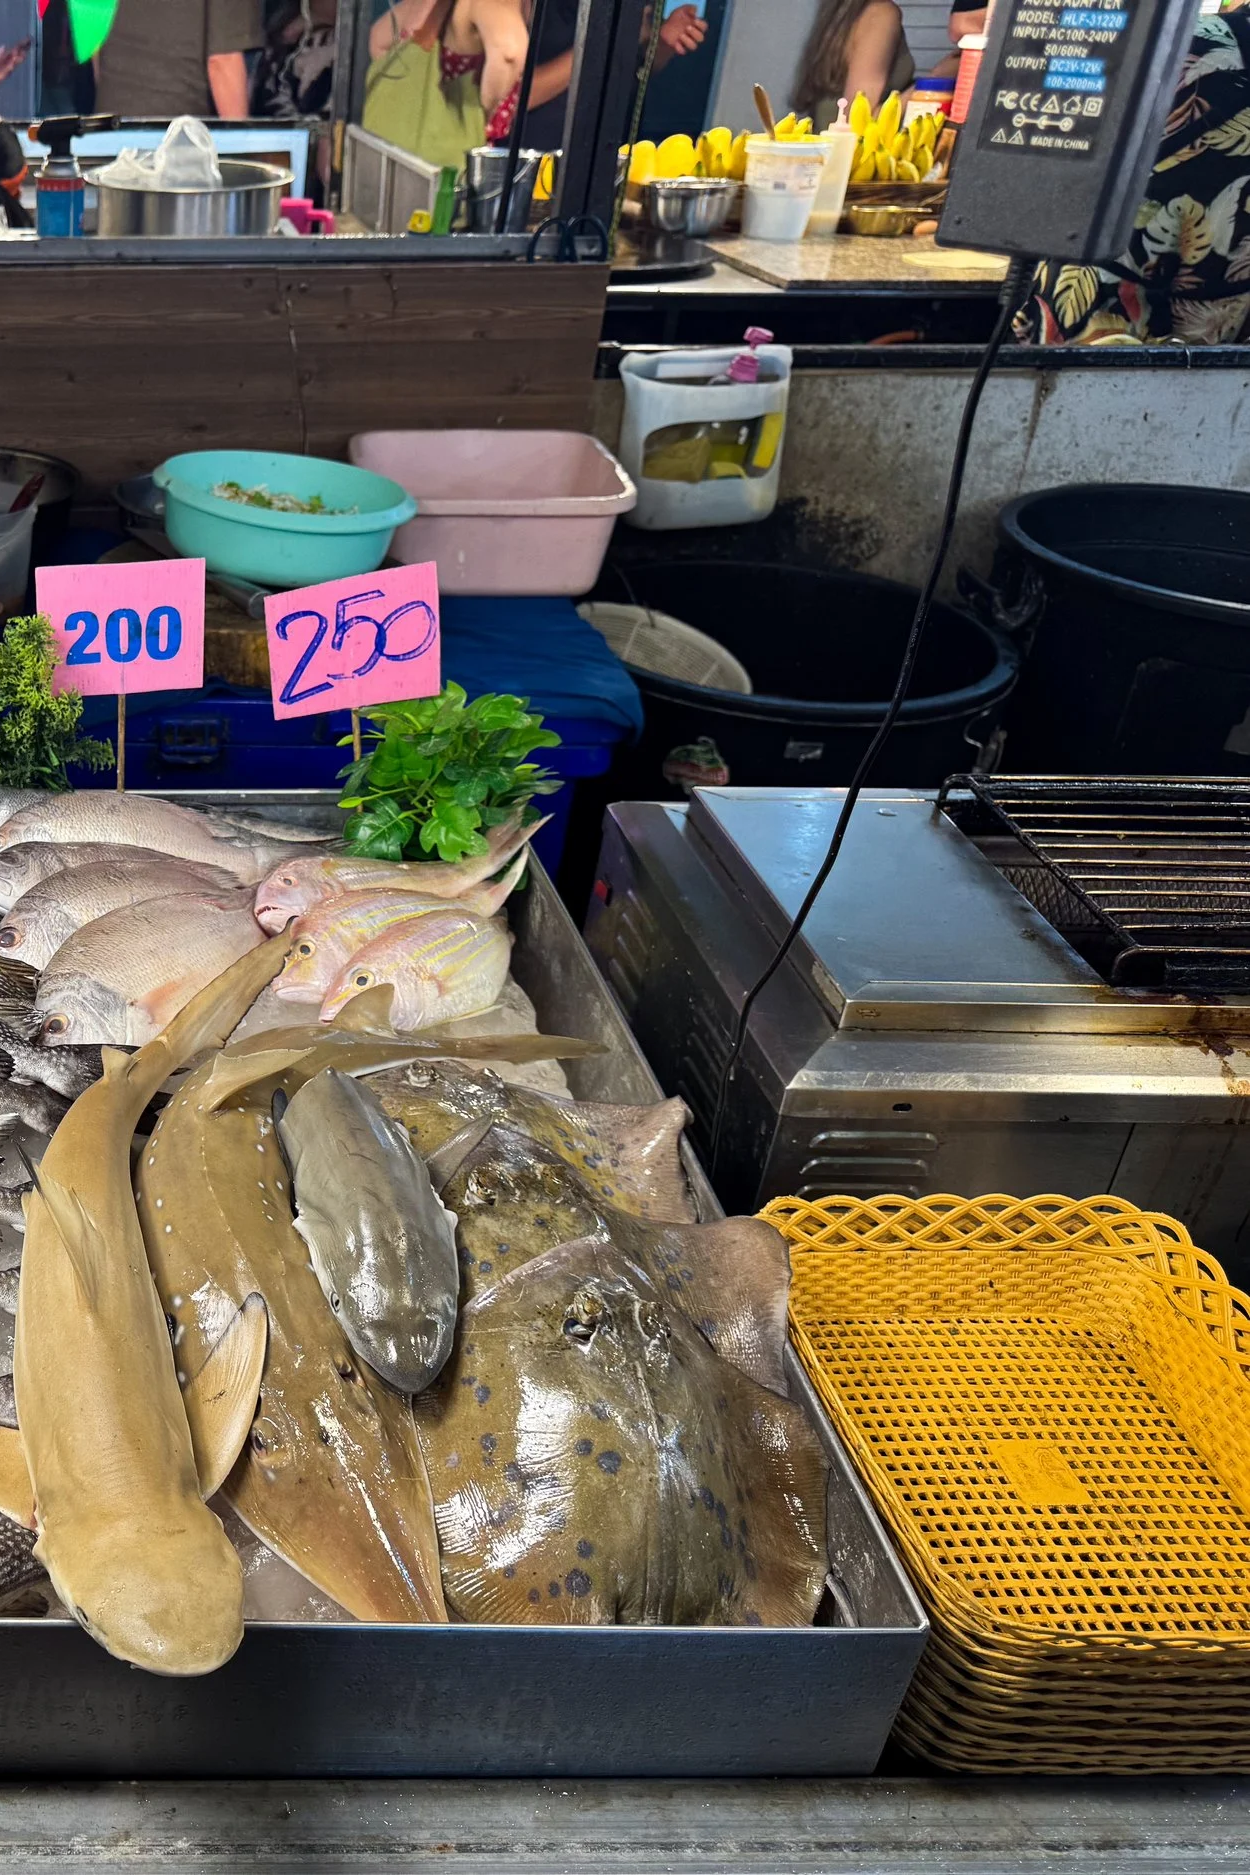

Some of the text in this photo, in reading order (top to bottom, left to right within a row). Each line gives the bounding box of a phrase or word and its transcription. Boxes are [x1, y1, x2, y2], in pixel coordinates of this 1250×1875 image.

[1017, 10, 1123, 28] MODEL: HLF-31220
[1044, 43, 1088, 58] 50/60Hz
[1005, 56, 1047, 70] OUTPUT:
[1030, 135, 1090, 151] MADE IN CHINA
[65, 605, 182, 665] 200
[276, 589, 436, 705] 250
